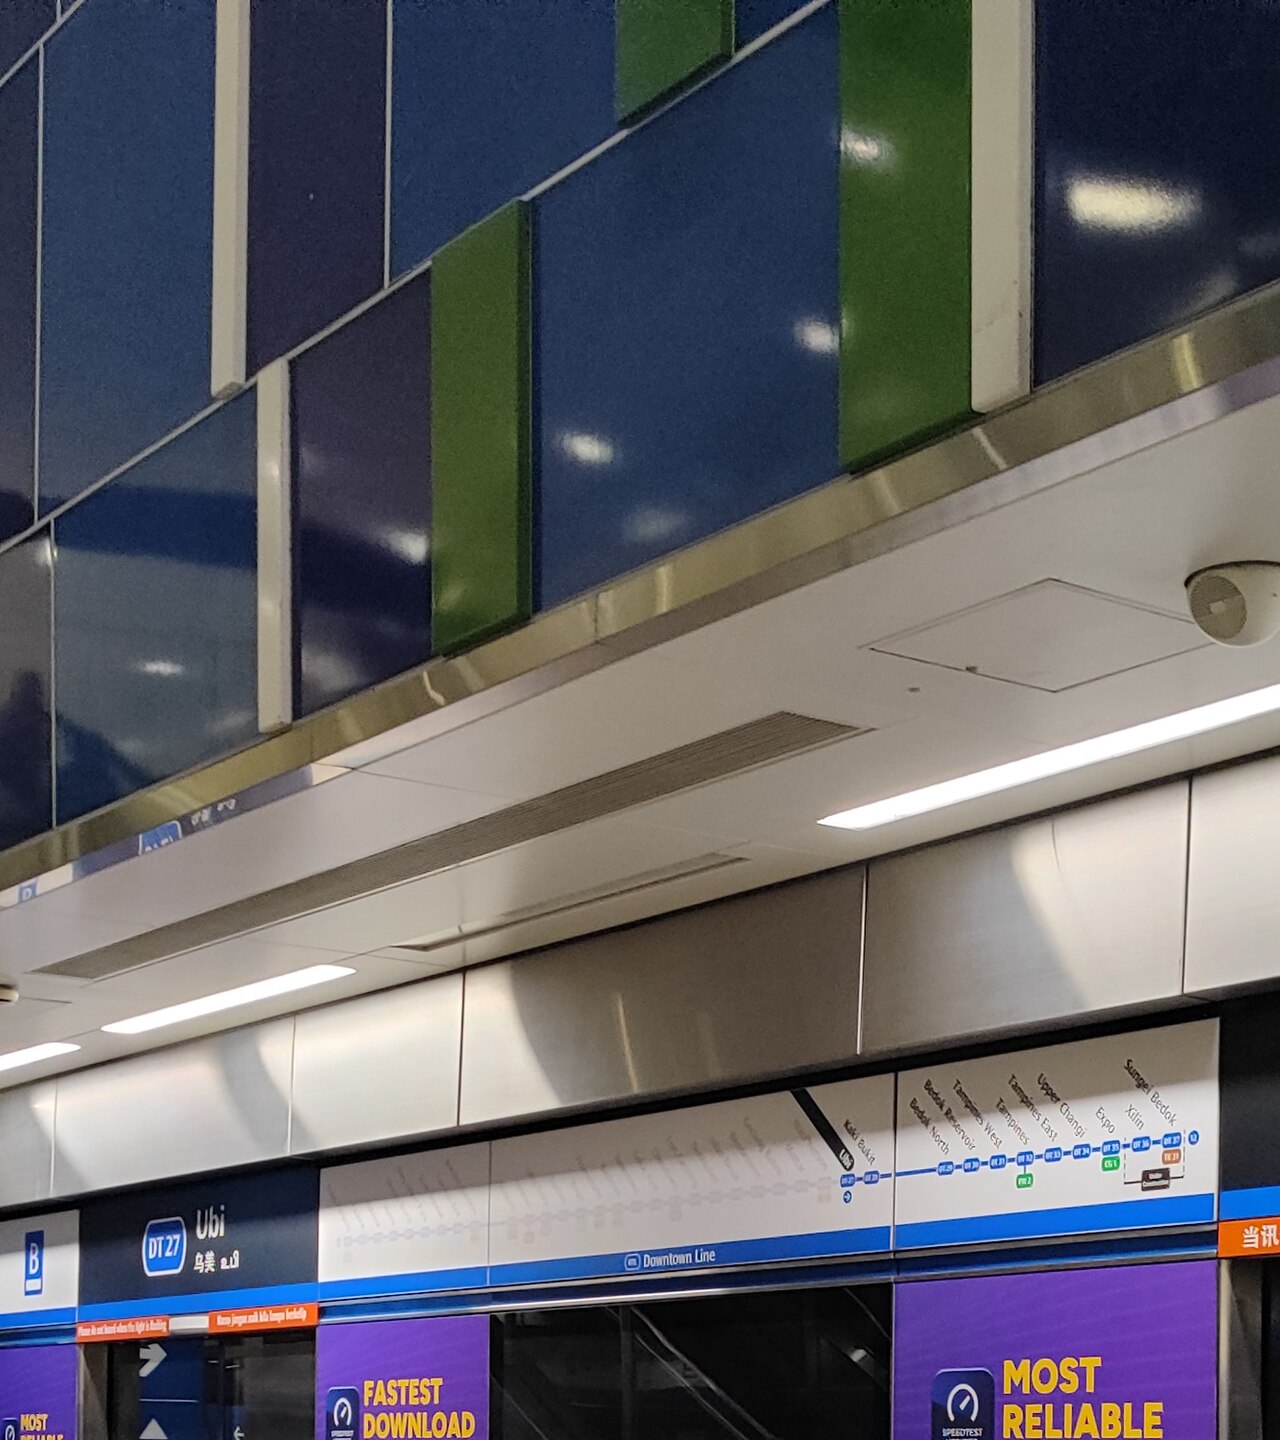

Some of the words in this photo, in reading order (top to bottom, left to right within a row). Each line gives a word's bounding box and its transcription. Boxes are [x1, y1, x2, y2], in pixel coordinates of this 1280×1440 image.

[1008, 1073, 1041, 1121] Tampines
[1040, 1118, 1058, 1142] East
[1037, 1073, 1060, 1104] Upper
[1060, 1102, 1088, 1138] Changi
[1124, 1059, 1154, 1095] Sungei
[1151, 1091, 1177, 1126] Bedok
[944, 1107, 976, 1150] Reservoir
[995, 1097, 1029, 1145] Tampines
[1095, 1106, 1115, 1134] Expo
[1125, 1104, 1145, 1130] Xilin
[929, 1126, 950, 1155] North
[984, 1121, 1002, 1150] West
[196, 1205, 225, 1239] Ubi
[30, 1243, 39, 1275] B
[148, 1236, 164, 1259] DT
[165, 1234, 182, 1257] 27
[643, 1253, 692, 1268] Downtown
[694, 1248, 716, 1263] Line
[1003, 1356, 1102, 1395] MOST
[363, 1378, 443, 1407] FASTEST
[363, 1411, 475, 1439] DOWNLOAD
[942, 1427, 984, 1437] SPEEDTEST
[1002, 1401, 1163, 1439] RELIABLE
